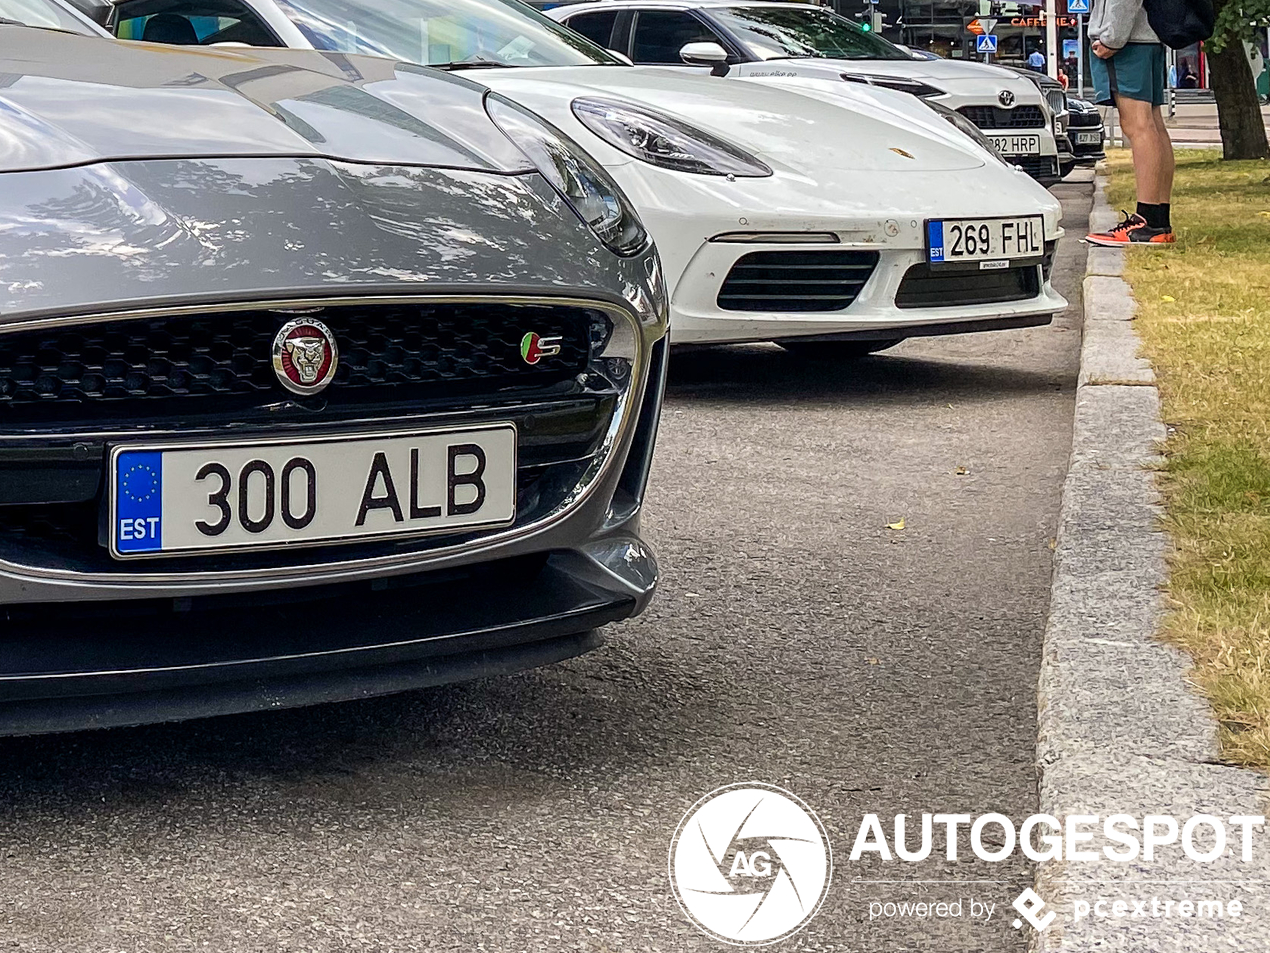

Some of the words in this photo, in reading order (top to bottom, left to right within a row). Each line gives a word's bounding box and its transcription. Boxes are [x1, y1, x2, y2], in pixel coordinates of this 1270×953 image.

[1011, 137, 1036, 152] HRP
[930, 247, 943, 257] EST
[949, 224, 990, 256] 269
[1001, 221, 1040, 254] FHL
[120, 516, 160, 541] EST
[194, 456, 317, 537] 300
[354, 443, 487, 527] ALB
